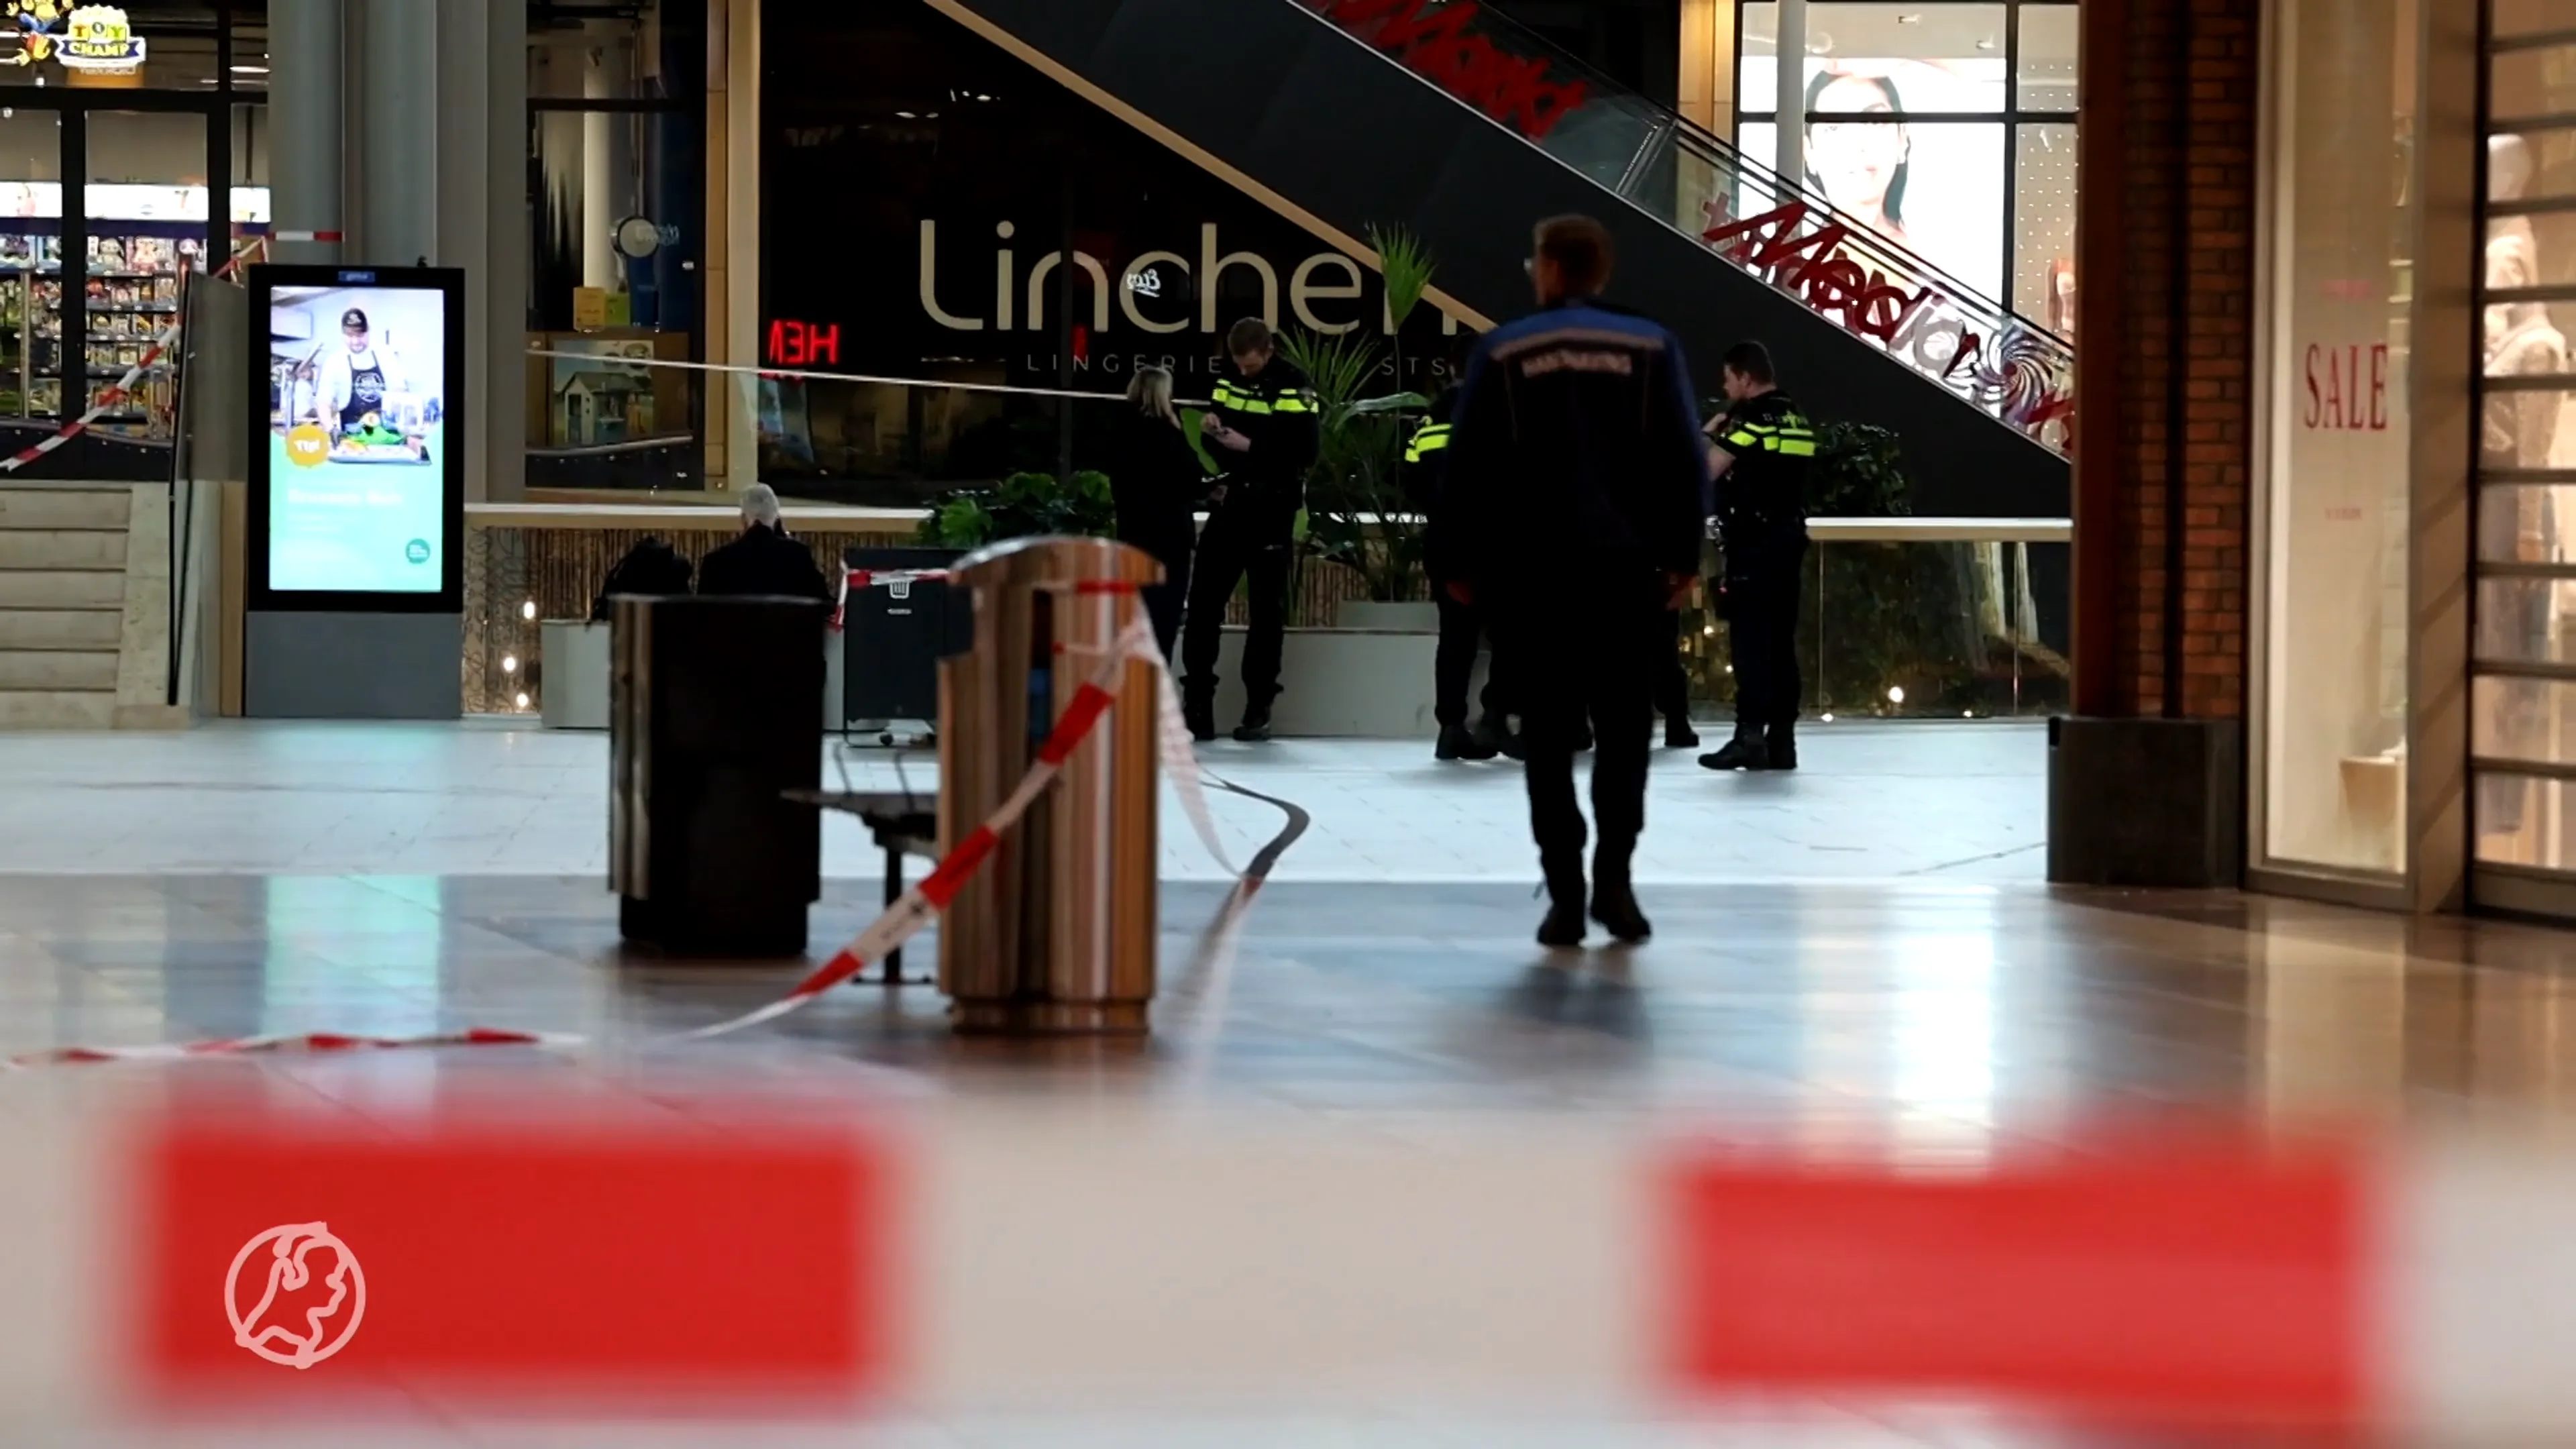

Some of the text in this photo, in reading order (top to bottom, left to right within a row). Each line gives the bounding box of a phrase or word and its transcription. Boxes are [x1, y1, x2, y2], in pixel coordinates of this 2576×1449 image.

[73, 22, 125, 38] TOY
[68, 42, 130, 57] CHAMP
[1027, 354, 1222, 374] LINGERIE
[2304, 343, 2388, 431] SALE
